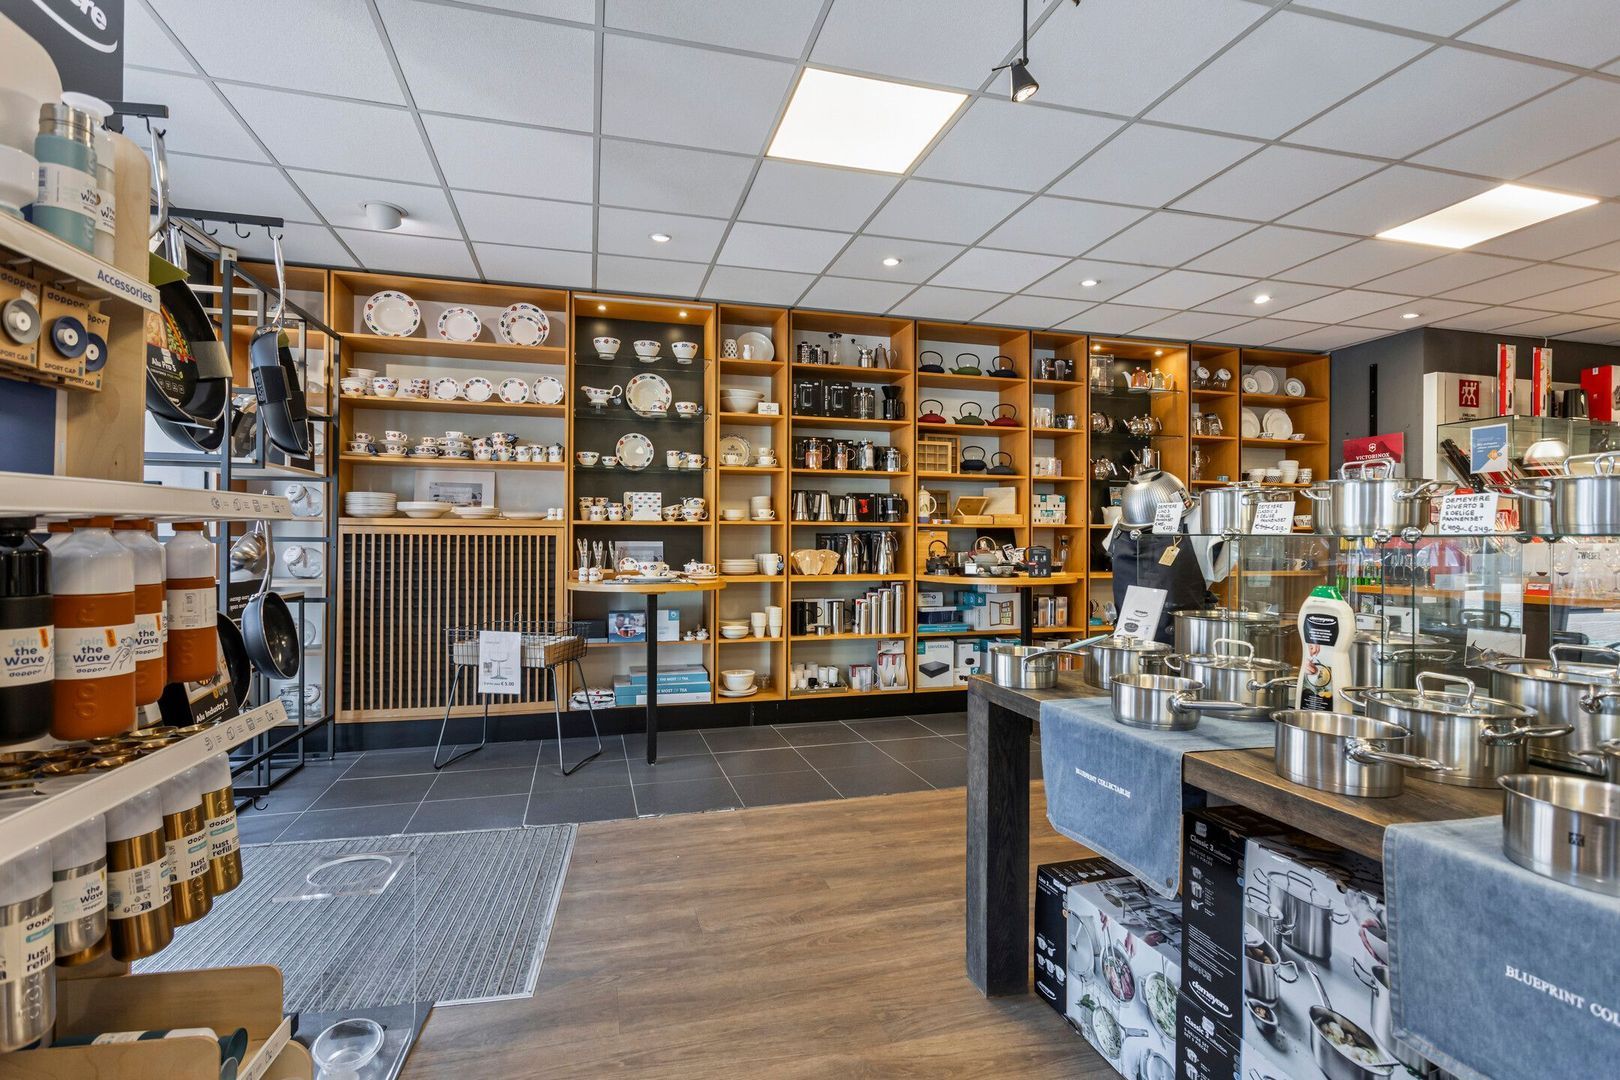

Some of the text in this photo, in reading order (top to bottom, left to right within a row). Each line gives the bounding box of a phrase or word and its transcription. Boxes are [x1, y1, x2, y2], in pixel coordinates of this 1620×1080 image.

[97, 269, 153, 303] Accessories
[0, 348, 28, 361] PORT CAP
[44, 362, 64, 371] SPORT
[1355, 452, 1390, 461] VICTORINOX
[1445, 495, 1491, 503] DEMEYERE
[138, 629, 155, 637] the
[14, 647, 38, 656] the
[81, 646, 103, 654] the
[4, 655, 45, 667] Wave
[72, 654, 111, 663] Wave
[9, 669, 42, 678] dopper
[204, 702, 225, 717] Industry
[212, 839, 229, 850] Just
[1190, 834, 1209, 849] Classic
[212, 845, 232, 857] refill
[190, 857, 205, 869] Just
[86, 885, 100, 895] the
[80, 890, 104, 904] Wave
[27, 946, 48, 962] Just
[26, 953, 51, 972] refill
[1504, 964, 1586, 1008] BLUEPRINT
[1192, 980, 1230, 1012] demeyere
[1184, 1015, 1204, 1036] Classic
